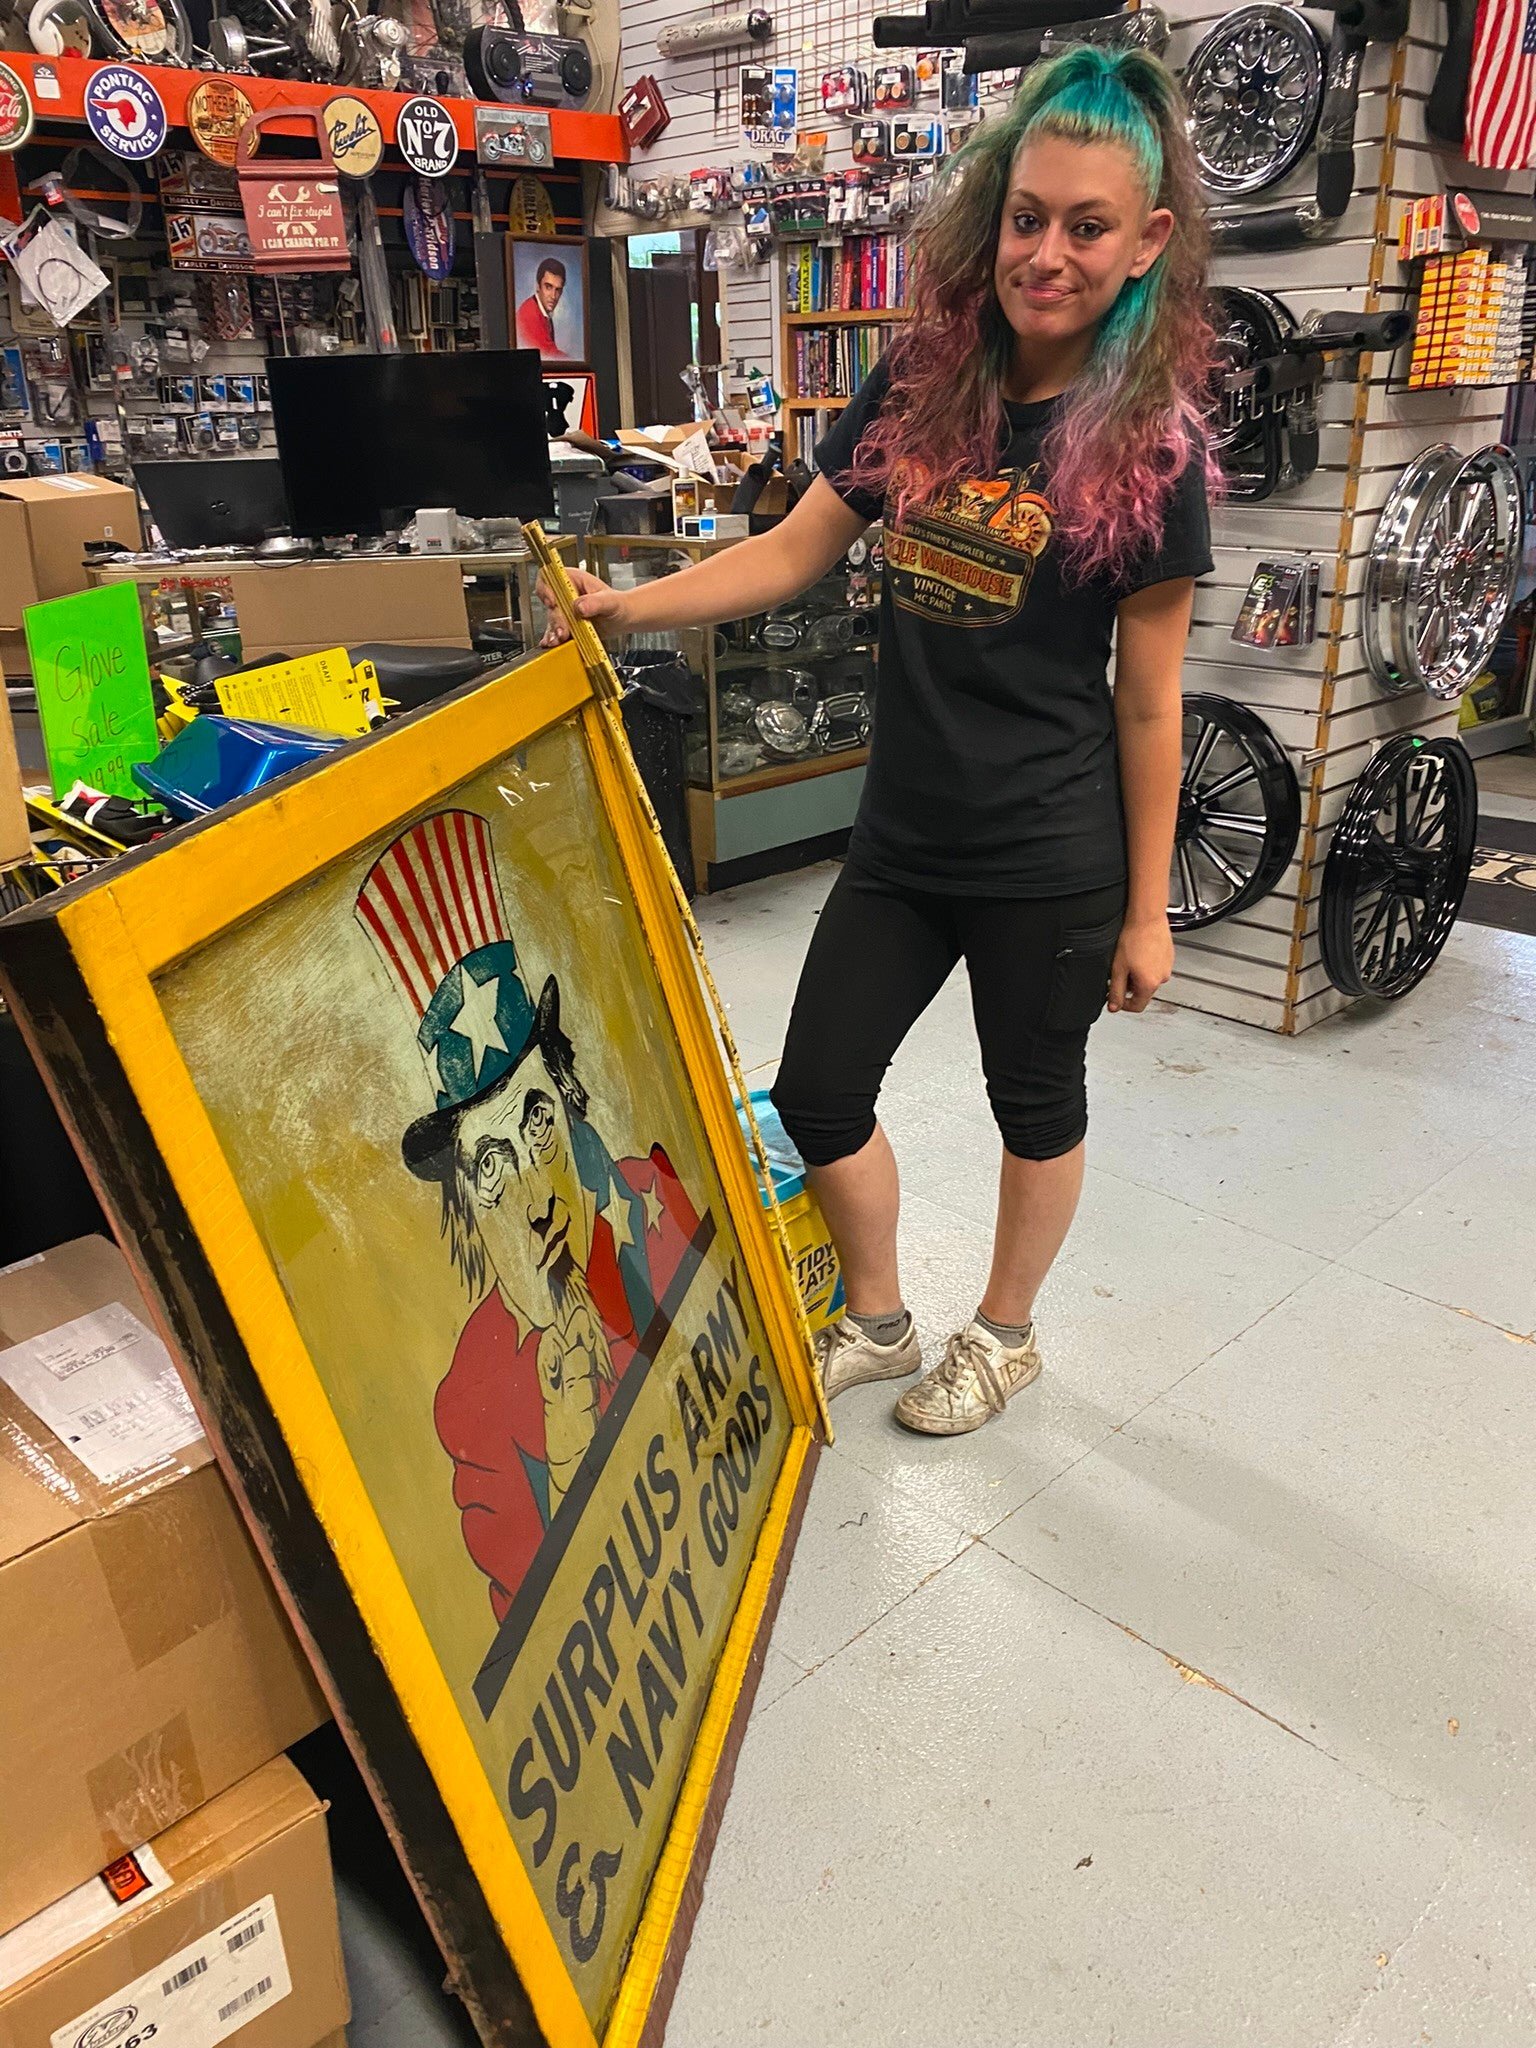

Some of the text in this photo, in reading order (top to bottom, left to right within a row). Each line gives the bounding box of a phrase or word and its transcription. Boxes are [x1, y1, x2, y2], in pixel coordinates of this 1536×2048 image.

[94, 73, 154, 104] PONTIAC
[0, 94, 24, 118] ola
[414, 105, 439, 118] OLD
[100, 125, 158, 153] SERVICE
[751, 128, 786, 143] DRAG
[414, 157, 448, 171] BRAND
[210, 200, 243, 208] DAVIDSO
[267, 205, 288, 218] can't
[305, 204, 333, 221] stupid
[920, 544, 1015, 599] WAREHOUSE
[914, 576, 957, 603] VINTAGE
[928, 596, 953, 614] PARTS
[55, 640, 126, 702] Glove
[319, 660, 332, 684] DRAFT
[71, 701, 126, 758] Sale
[796, 1243, 833, 1281] TIDY
[798, 1256, 836, 1298] ATS
[508, 1256, 751, 1868] SURPLUS ARMY
[556, 1354, 773, 1964] & NAVY GOODS
